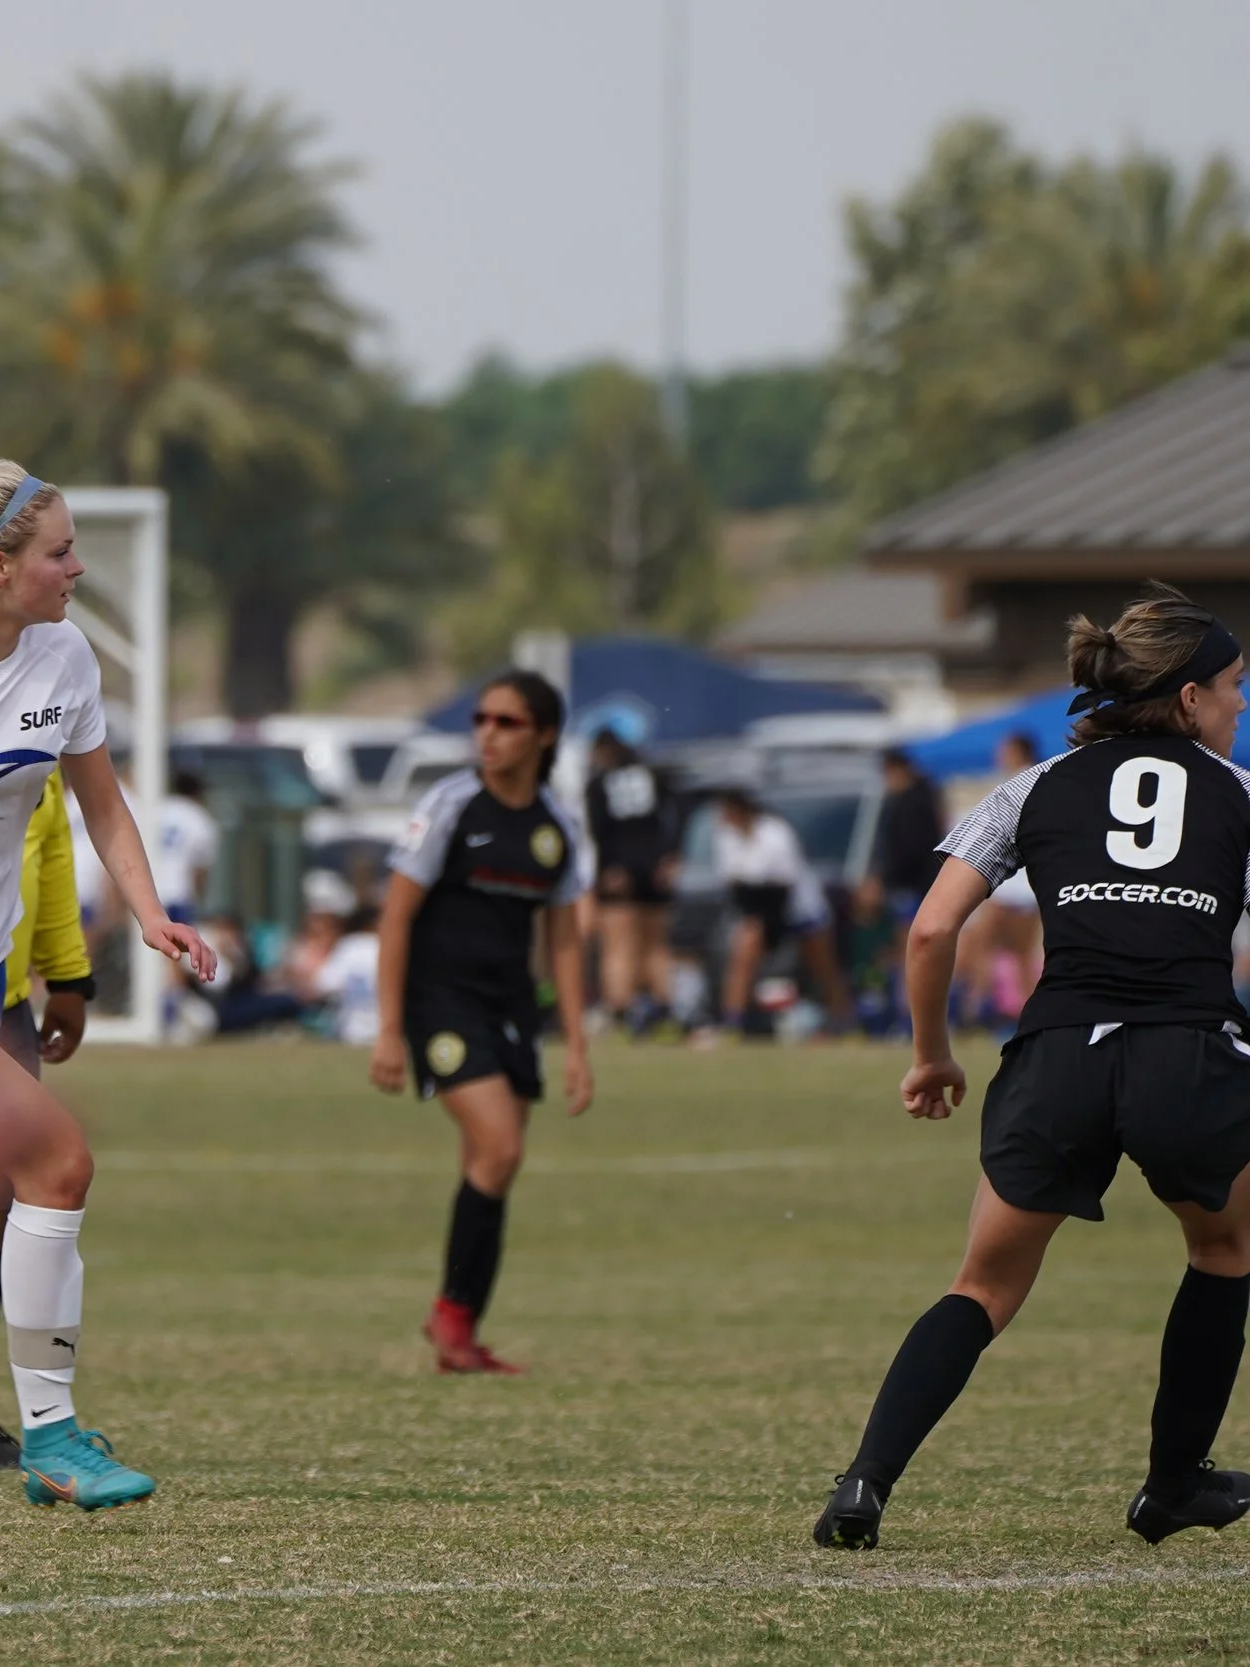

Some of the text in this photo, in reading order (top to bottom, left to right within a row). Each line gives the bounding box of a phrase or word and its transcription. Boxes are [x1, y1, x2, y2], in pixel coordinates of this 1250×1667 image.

[20, 706, 62, 731] SURF
[1106, 756, 1188, 870] 9
[1056, 882, 1218, 915] SOCCER.COM
